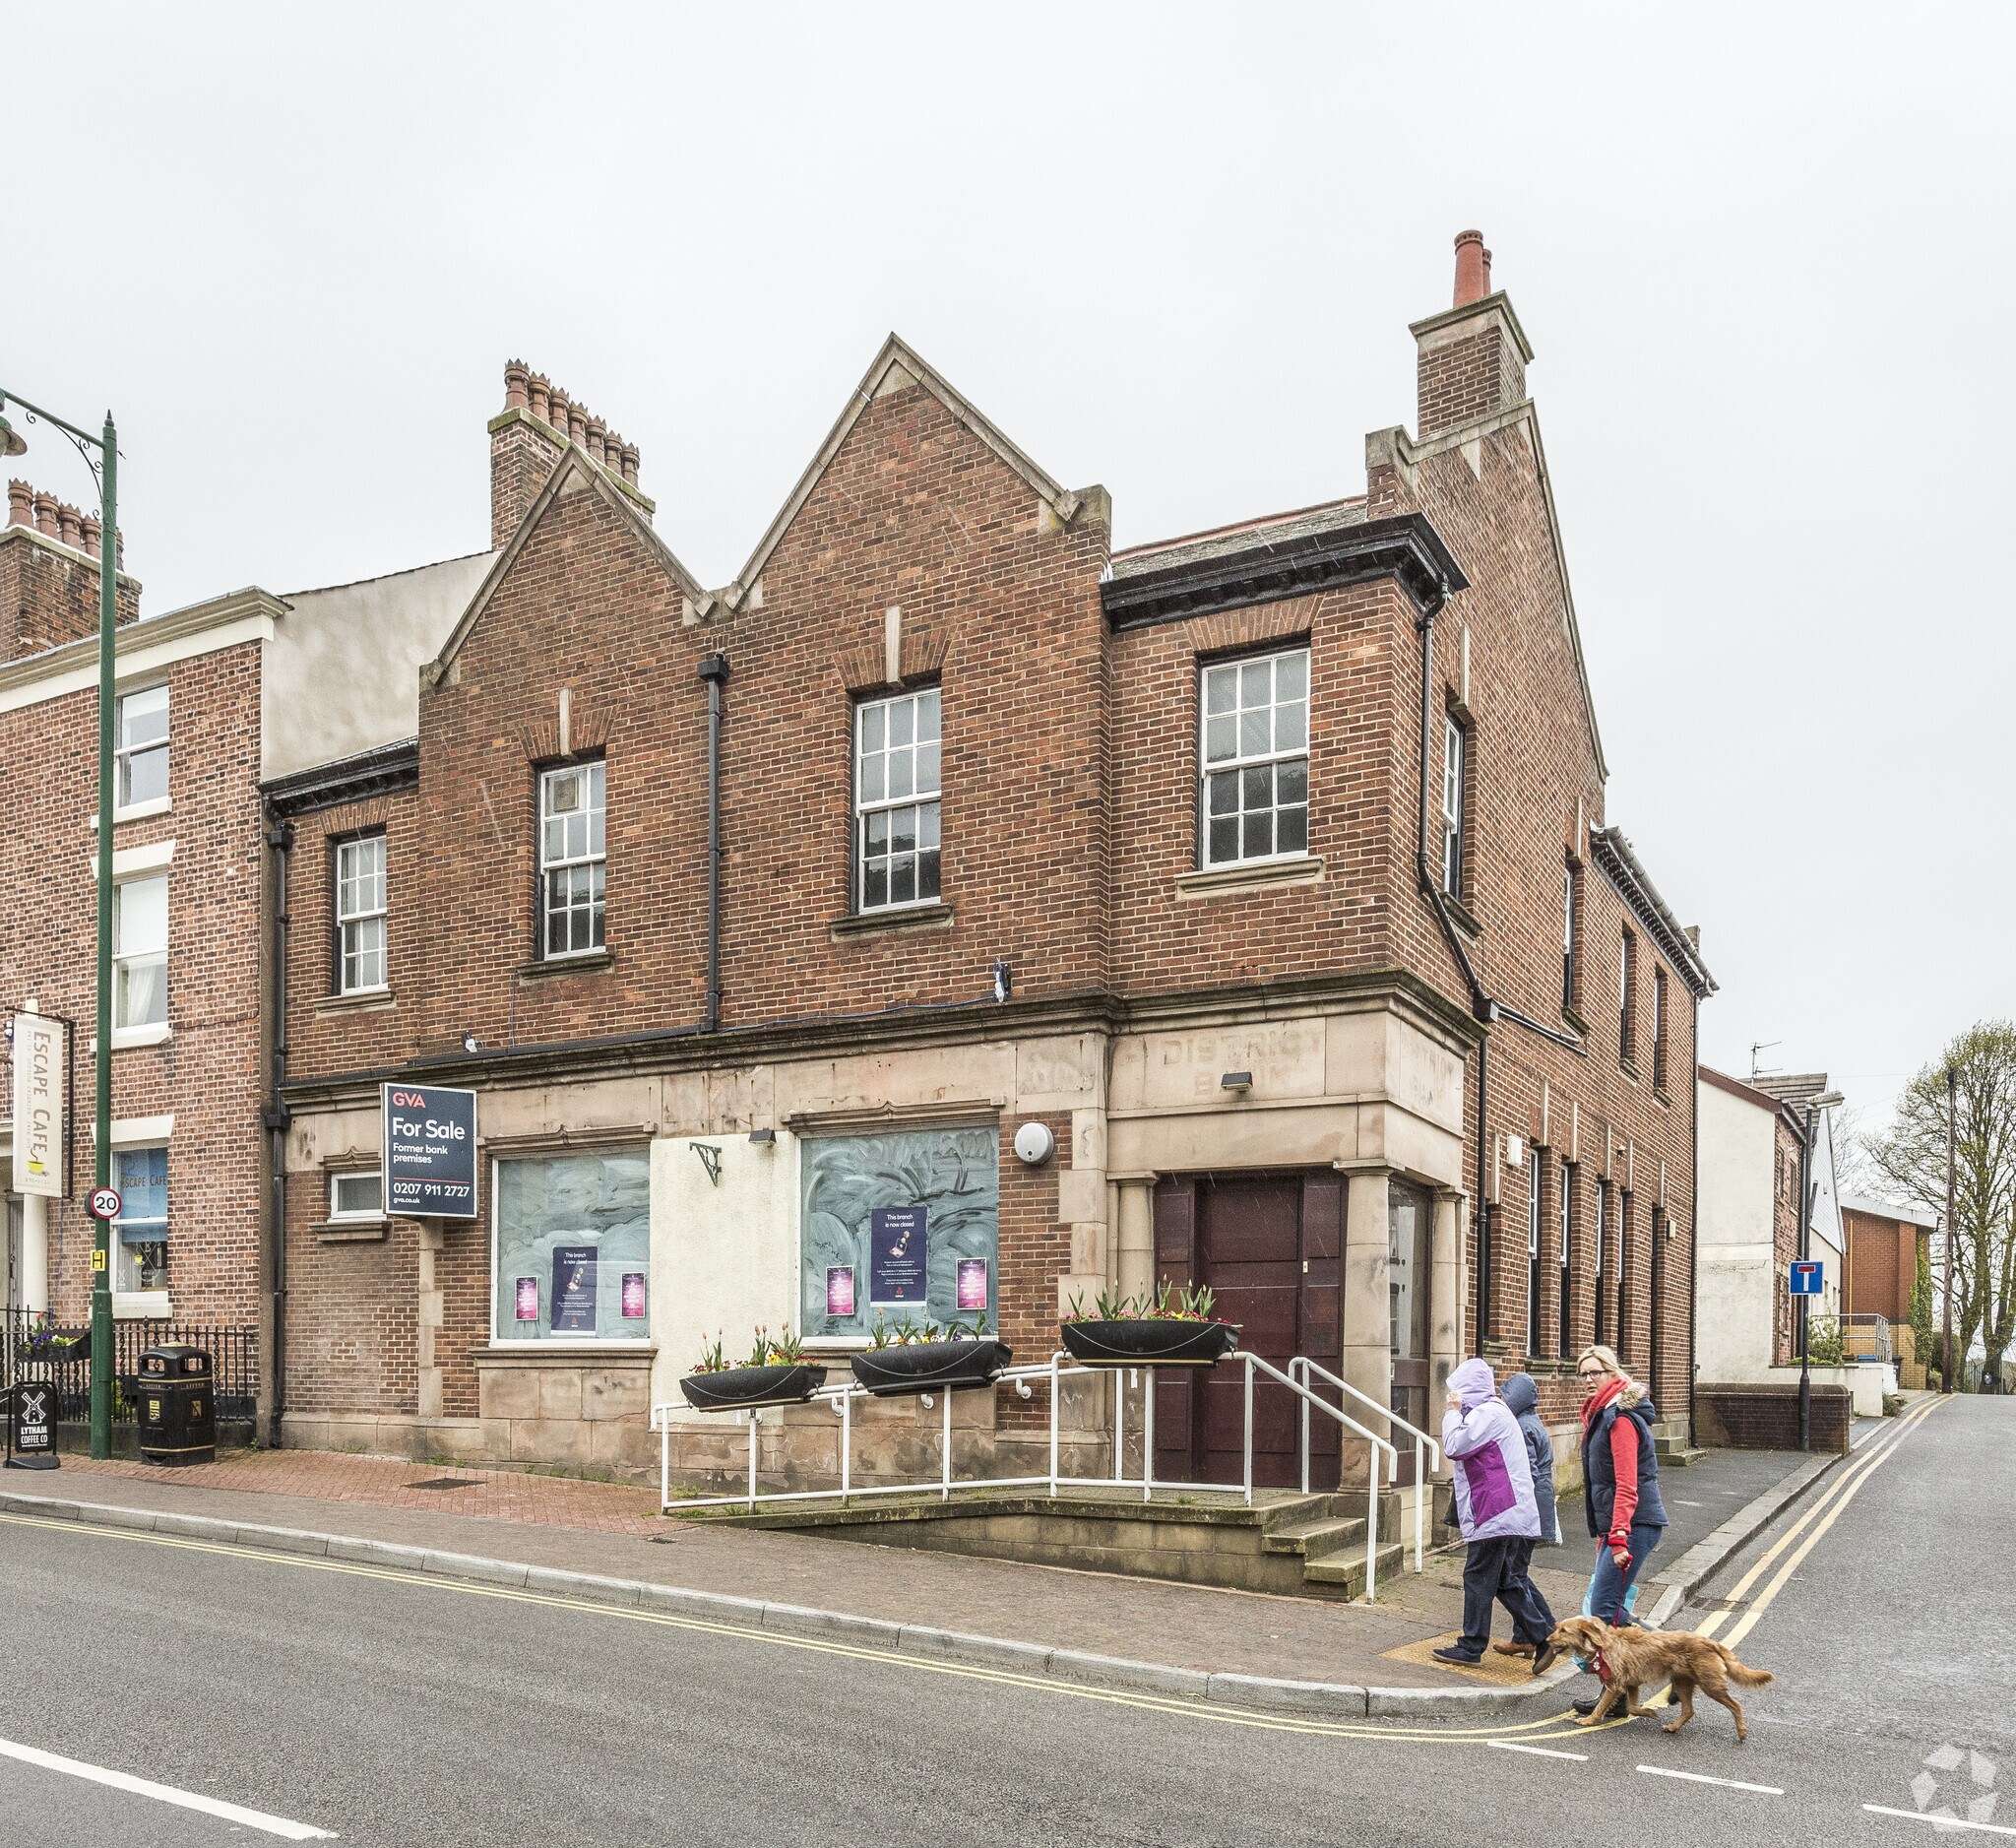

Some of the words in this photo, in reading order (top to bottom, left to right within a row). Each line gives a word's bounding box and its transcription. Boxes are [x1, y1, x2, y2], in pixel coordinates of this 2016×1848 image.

[33, 1031, 51, 1098] ESCAPE
[392, 1092, 426, 1109] GVA
[33, 1109, 50, 1153] CAFE
[392, 1116, 422, 1137] For
[425, 1119, 466, 1140] Sale
[393, 1142, 424, 1153] Former
[425, 1144, 449, 1155] bank
[393, 1154, 432, 1164] premises
[150, 1175, 167, 1186] CAFE
[394, 1182, 422, 1194] 0207
[424, 1183, 441, 1196] 911
[444, 1185, 471, 1197] 2727
[95, 1196, 117, 1210] 20
[92, 1251, 103, 1269] H
[21, 1426, 48, 1435] LYTHAM
[21, 1434, 39, 1444] COFFEE
[40, 1434, 48, 1443] CO
